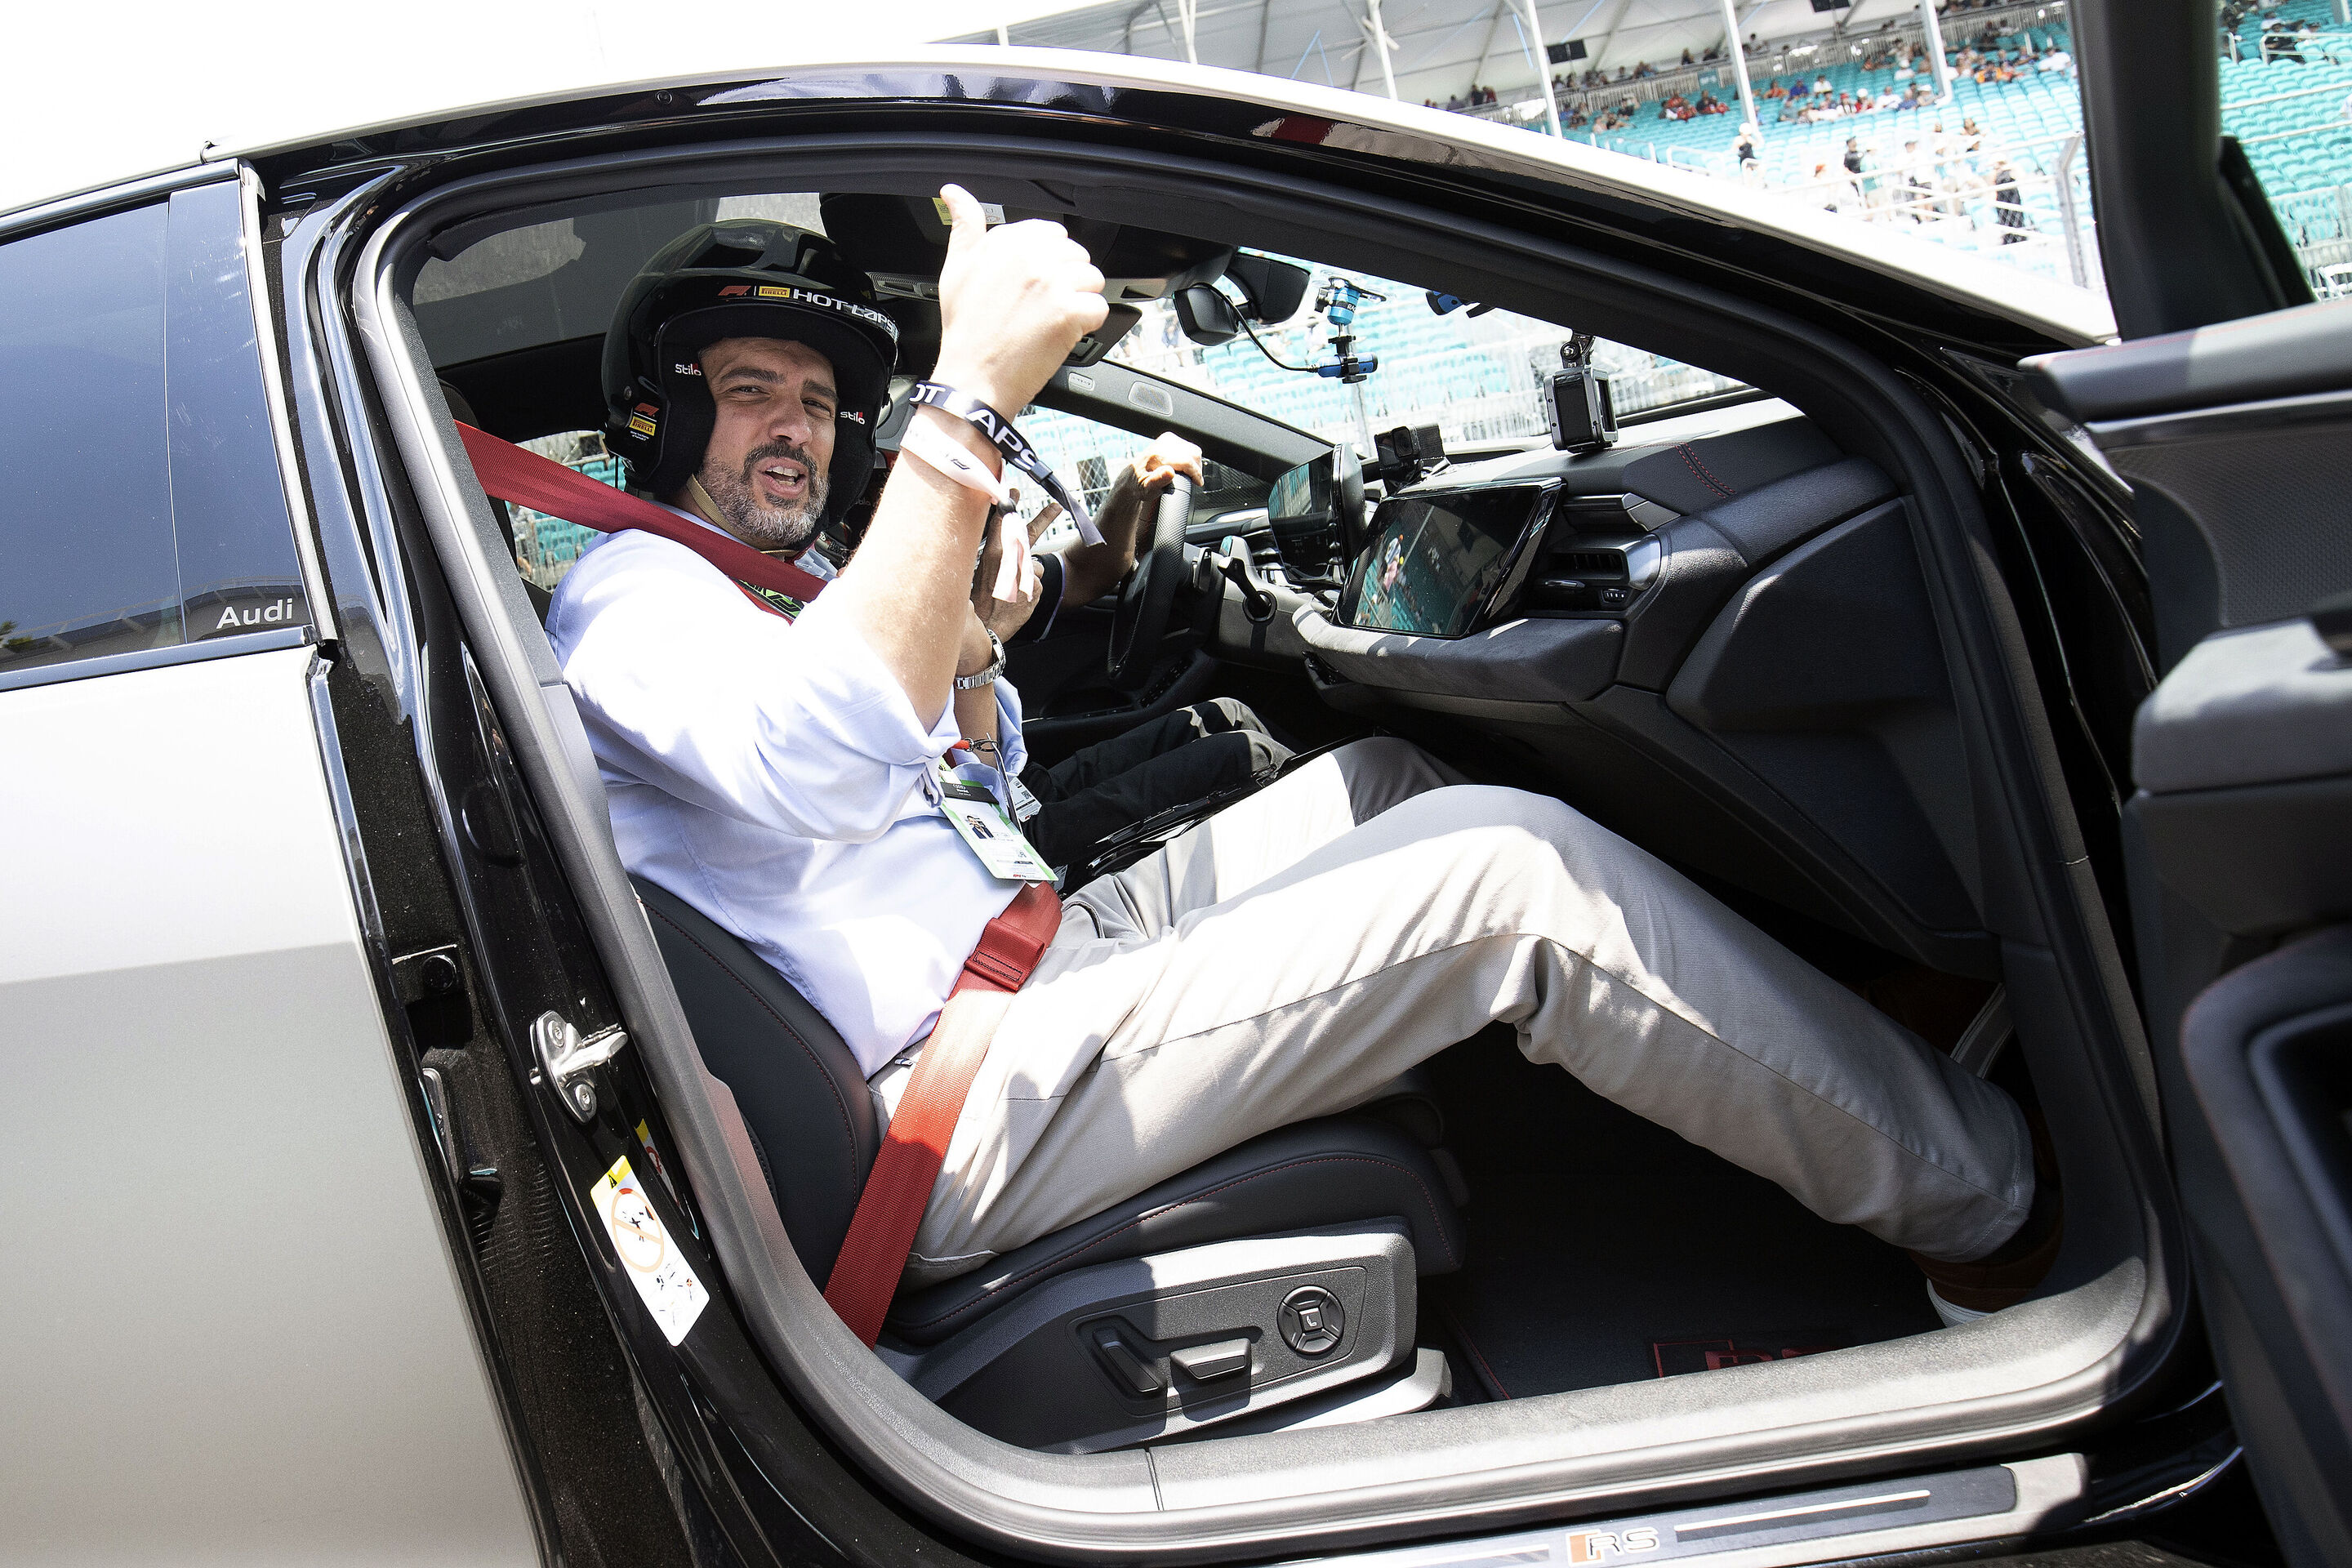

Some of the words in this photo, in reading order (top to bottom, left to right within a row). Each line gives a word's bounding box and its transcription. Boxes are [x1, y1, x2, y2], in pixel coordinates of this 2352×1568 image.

[760, 287, 789, 296] PIRELLI
[793, 288, 848, 310] HOT
[632, 418, 654, 433] PIRELLI
[216, 599, 293, 630] Audi
[1584, 1526, 1660, 1561] RS
